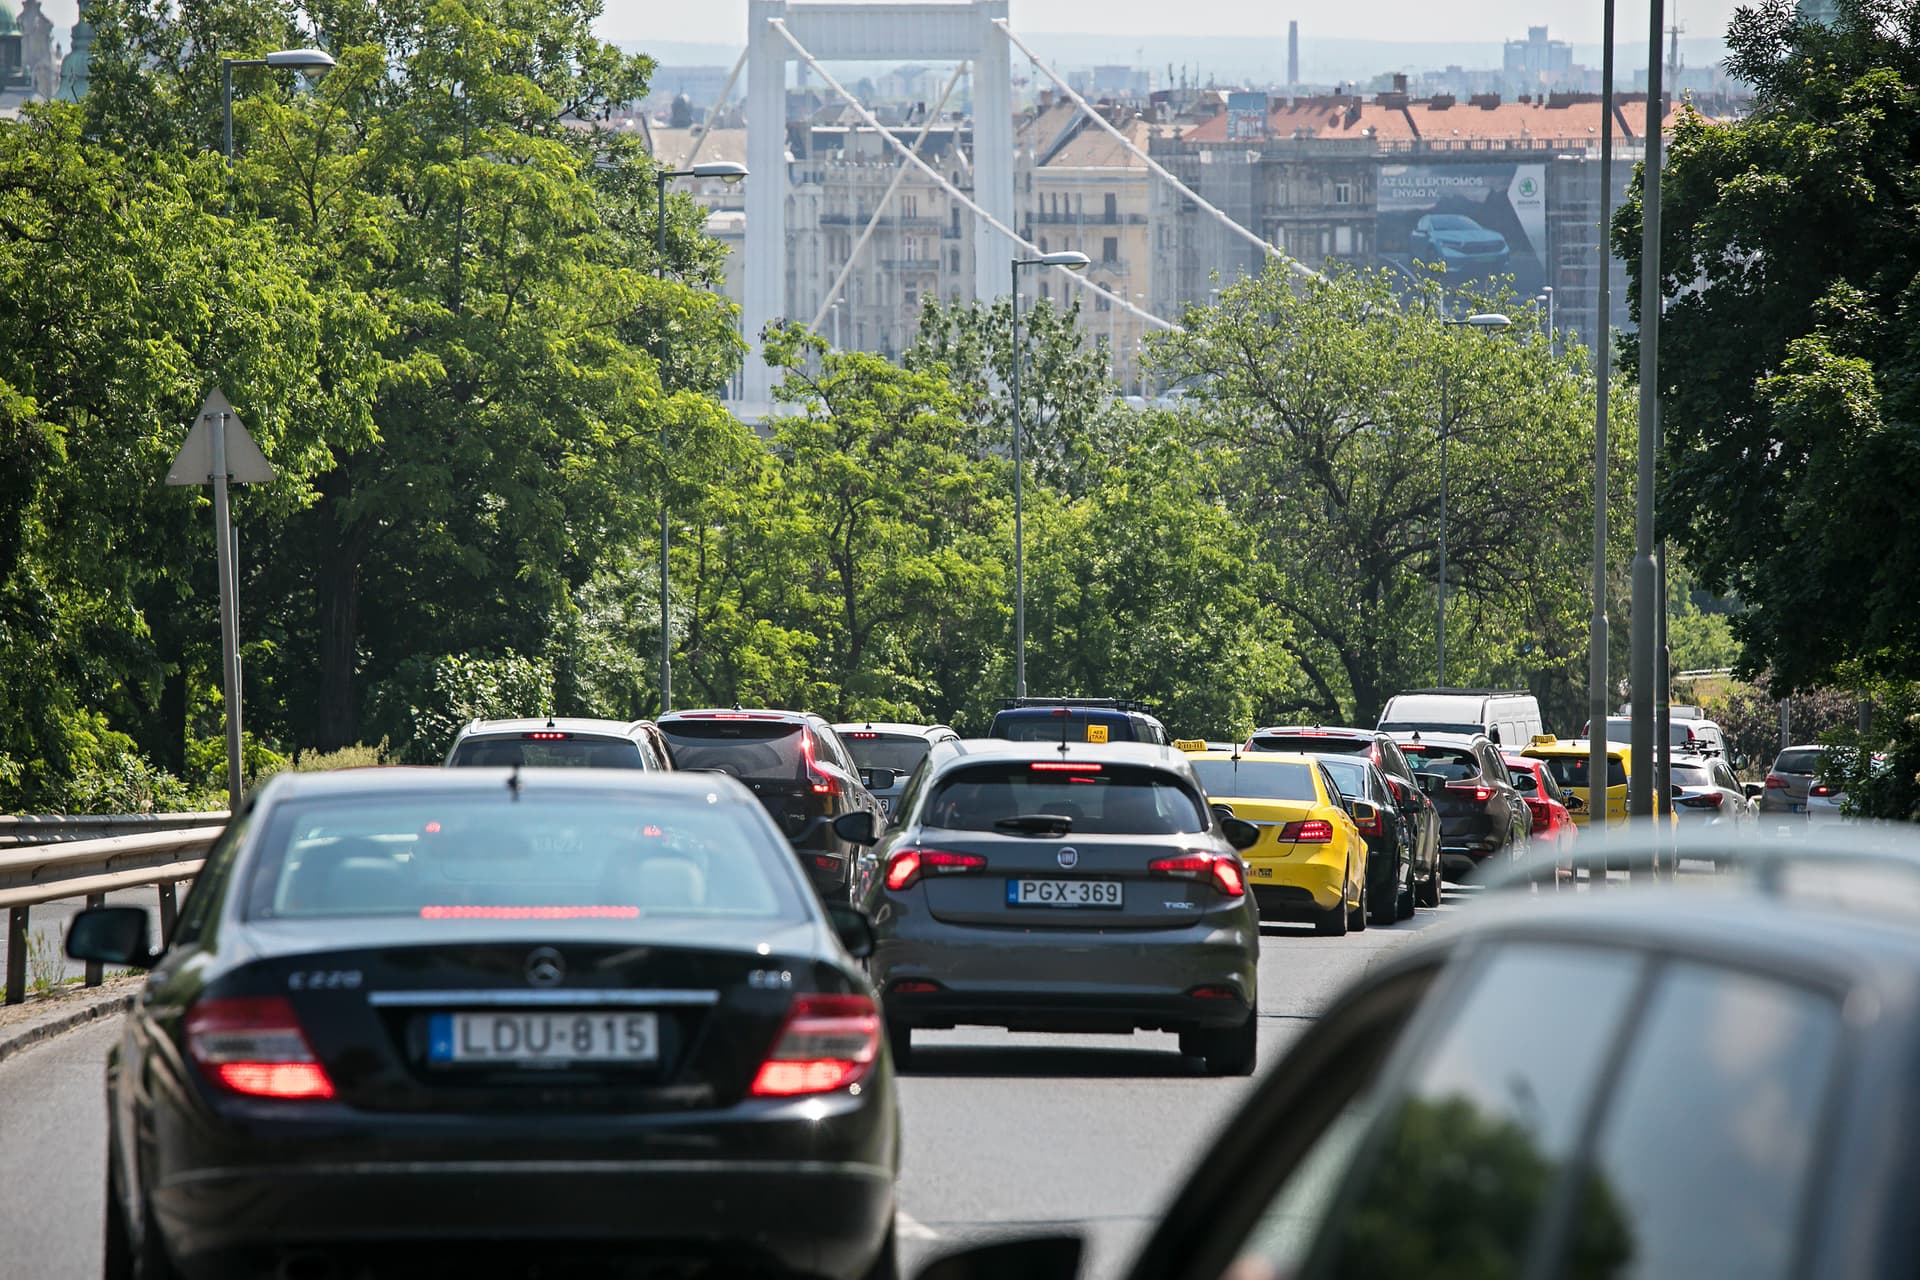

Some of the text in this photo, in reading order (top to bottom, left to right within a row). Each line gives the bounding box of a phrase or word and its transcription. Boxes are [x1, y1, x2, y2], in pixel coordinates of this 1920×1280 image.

[1382, 177, 1397, 186] AZ
[1415, 177, 1483, 186] ELEKTROMOS
[1392, 189, 1425, 198] ENYAQ
[1023, 882, 1117, 903] PGX-369
[461, 1016, 647, 1054] LDU-815
